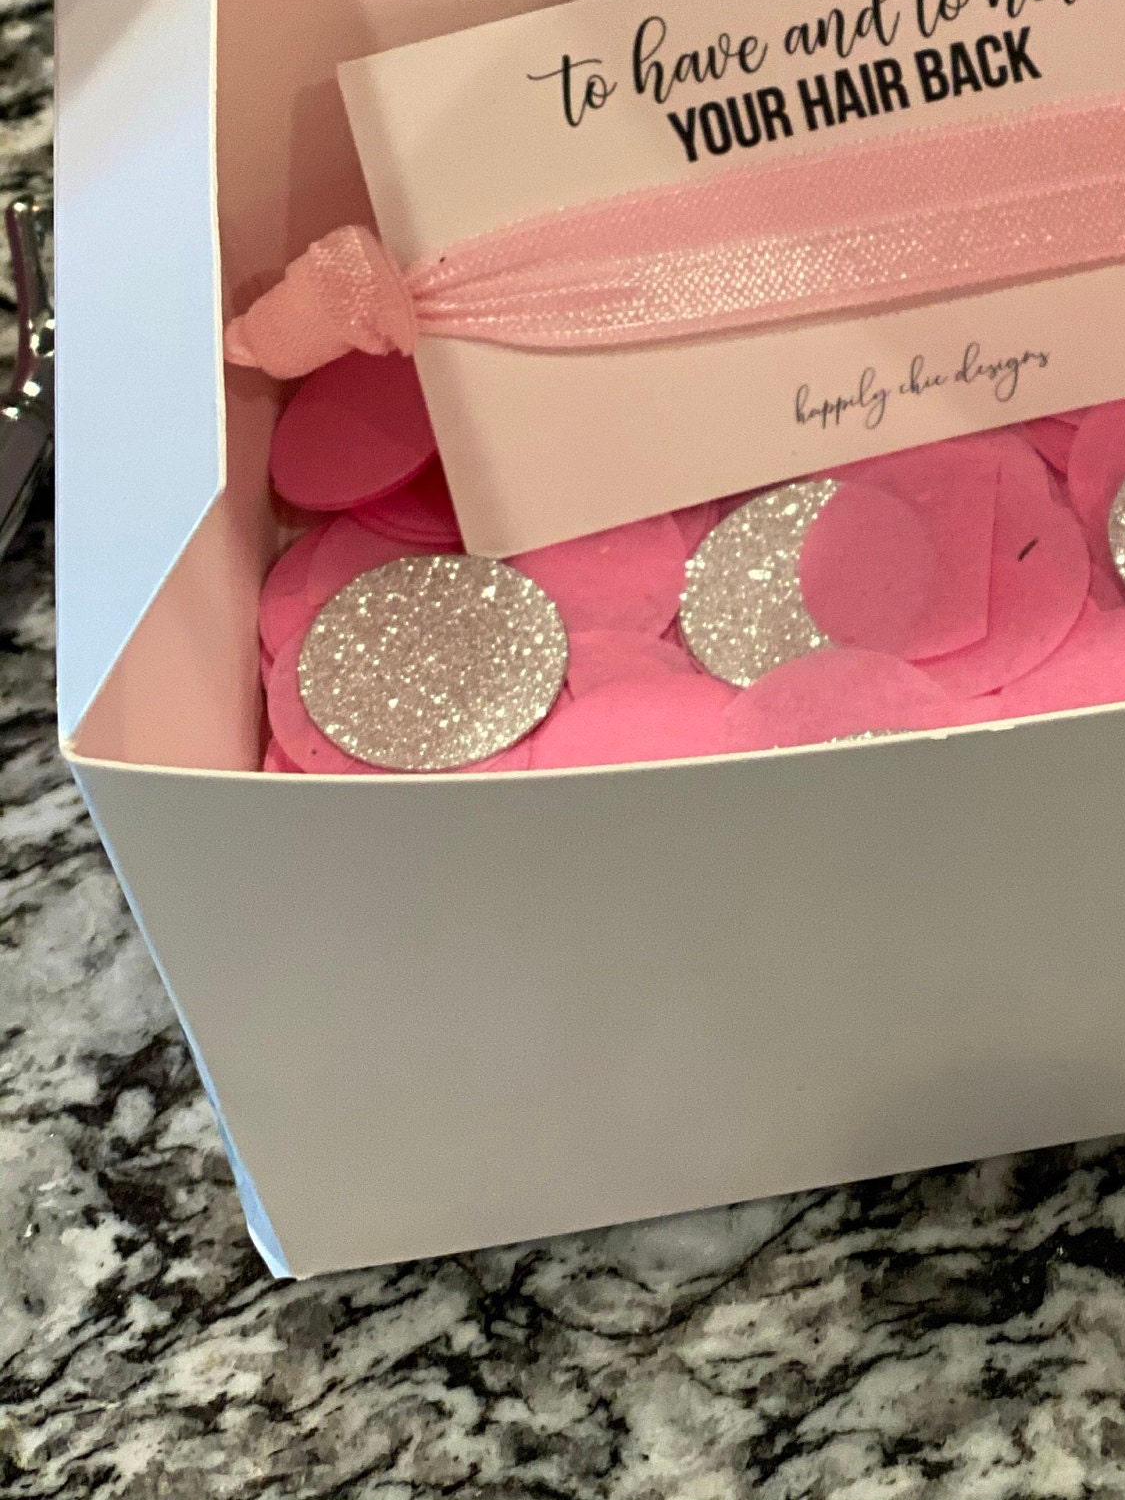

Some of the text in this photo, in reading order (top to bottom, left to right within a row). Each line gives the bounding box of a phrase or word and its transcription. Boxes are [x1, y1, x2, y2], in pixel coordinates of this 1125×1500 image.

[527, 54, 617, 128] to
[632, 15, 768, 105] have
[667, 26, 1042, 162] YOUR HAIR BACK
[795, 366, 892, 430] happily
[955, 341, 1052, 403] designs
